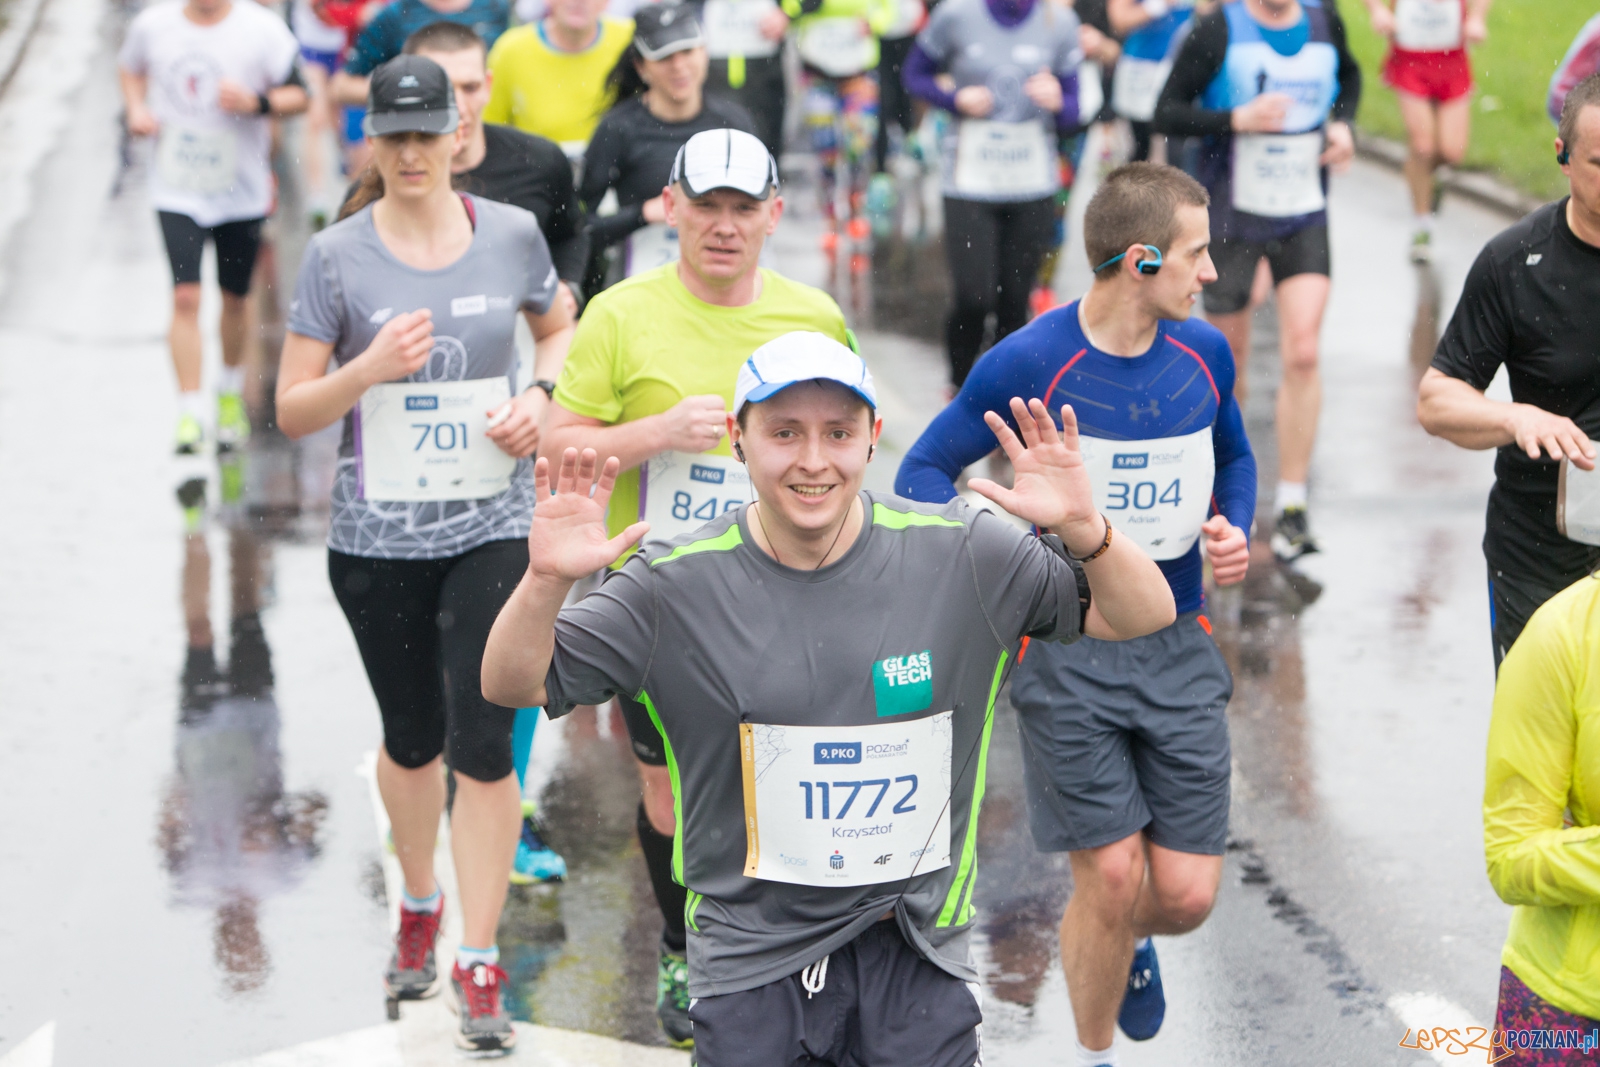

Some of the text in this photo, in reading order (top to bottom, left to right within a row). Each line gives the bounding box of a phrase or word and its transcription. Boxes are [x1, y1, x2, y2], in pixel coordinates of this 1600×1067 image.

[411, 423, 468, 451] 701
[694, 468, 721, 481] 9.PKO
[1106, 478, 1183, 510] 304
[1128, 515, 1160, 524] Adrian
[882, 652, 931, 673] GLAS
[884, 664, 933, 687] TECH
[820, 748, 856, 760] 9.PKO
[799, 774, 919, 820] 11772
[832, 822, 893, 839] Krzysztof
